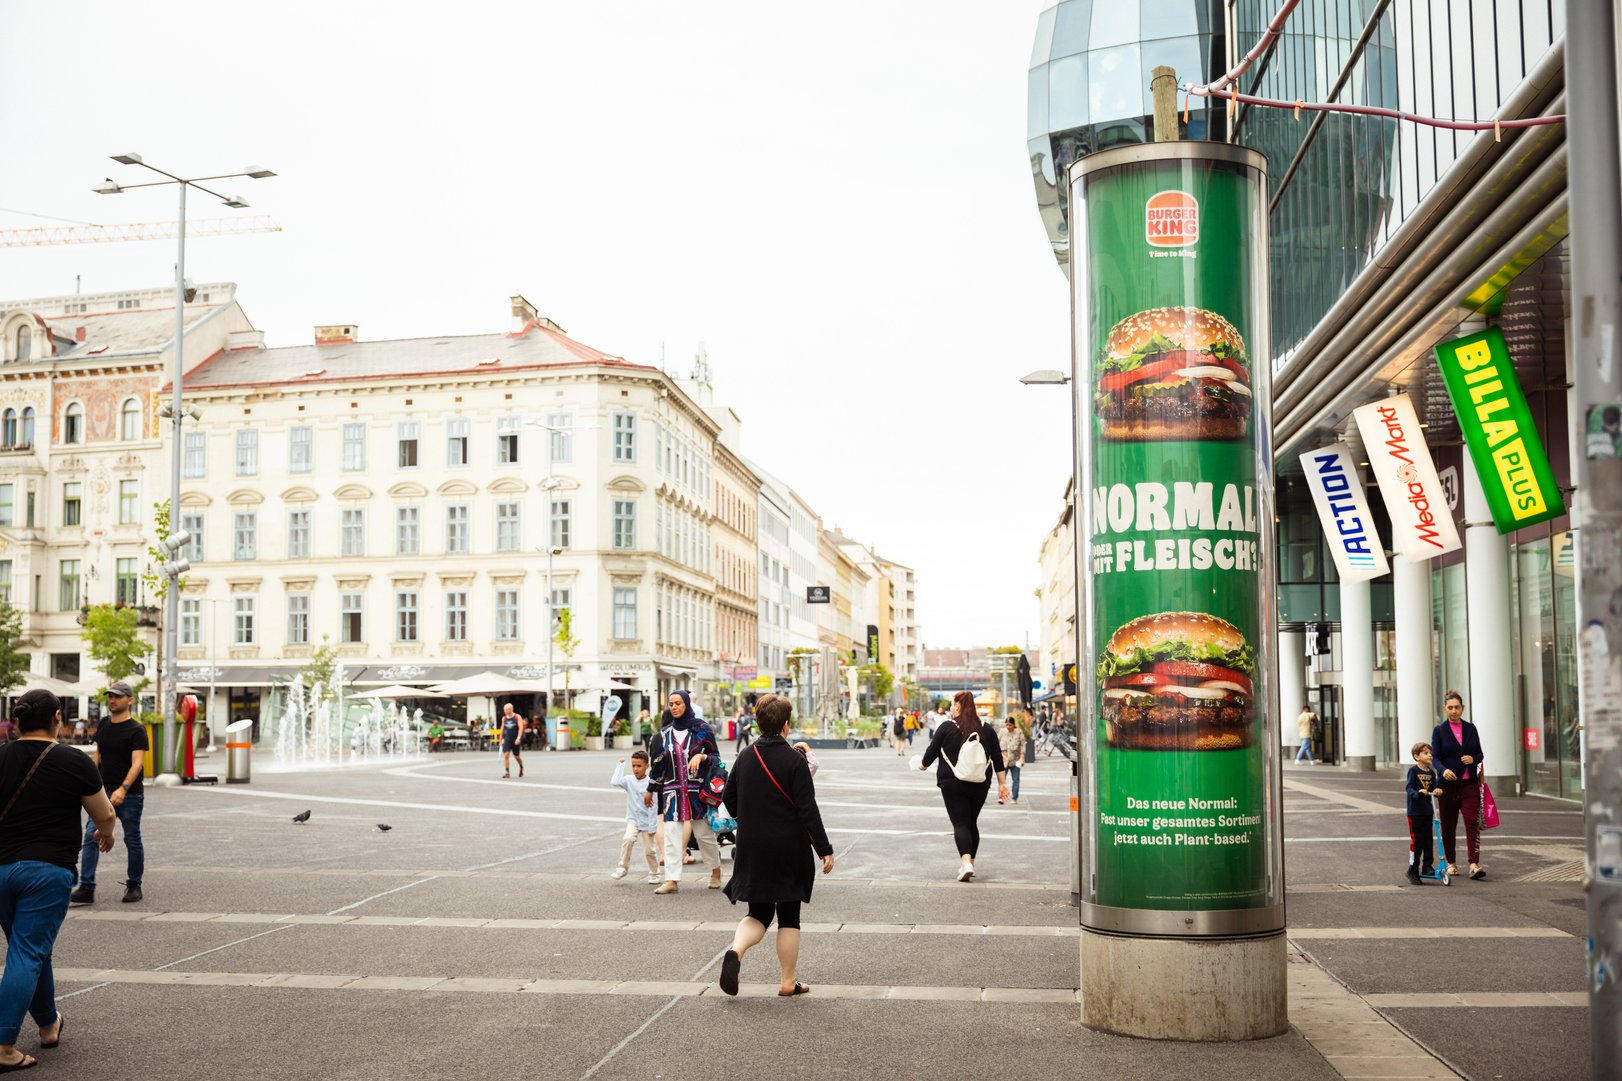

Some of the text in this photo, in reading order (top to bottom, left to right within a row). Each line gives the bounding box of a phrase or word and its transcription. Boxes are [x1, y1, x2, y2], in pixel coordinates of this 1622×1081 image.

[1147, 209, 1197, 220] BURGER
[1148, 220, 1197, 235] KING
[1148, 250, 1169, 258] Time
[1455, 339, 1537, 511] BILLA PLUS
[1377, 406, 1444, 549] Media Markt
[1093, 482, 1256, 535] NORMAL
[1314, 453, 1372, 554] ACTION
[1127, 797, 1238, 810] Das neue Normal:
[1100, 812, 1261, 830] Fast unser gesamtes Sortimen
[1113, 831, 1139, 846] jetzt
[1140, 833, 1172, 845] auch
